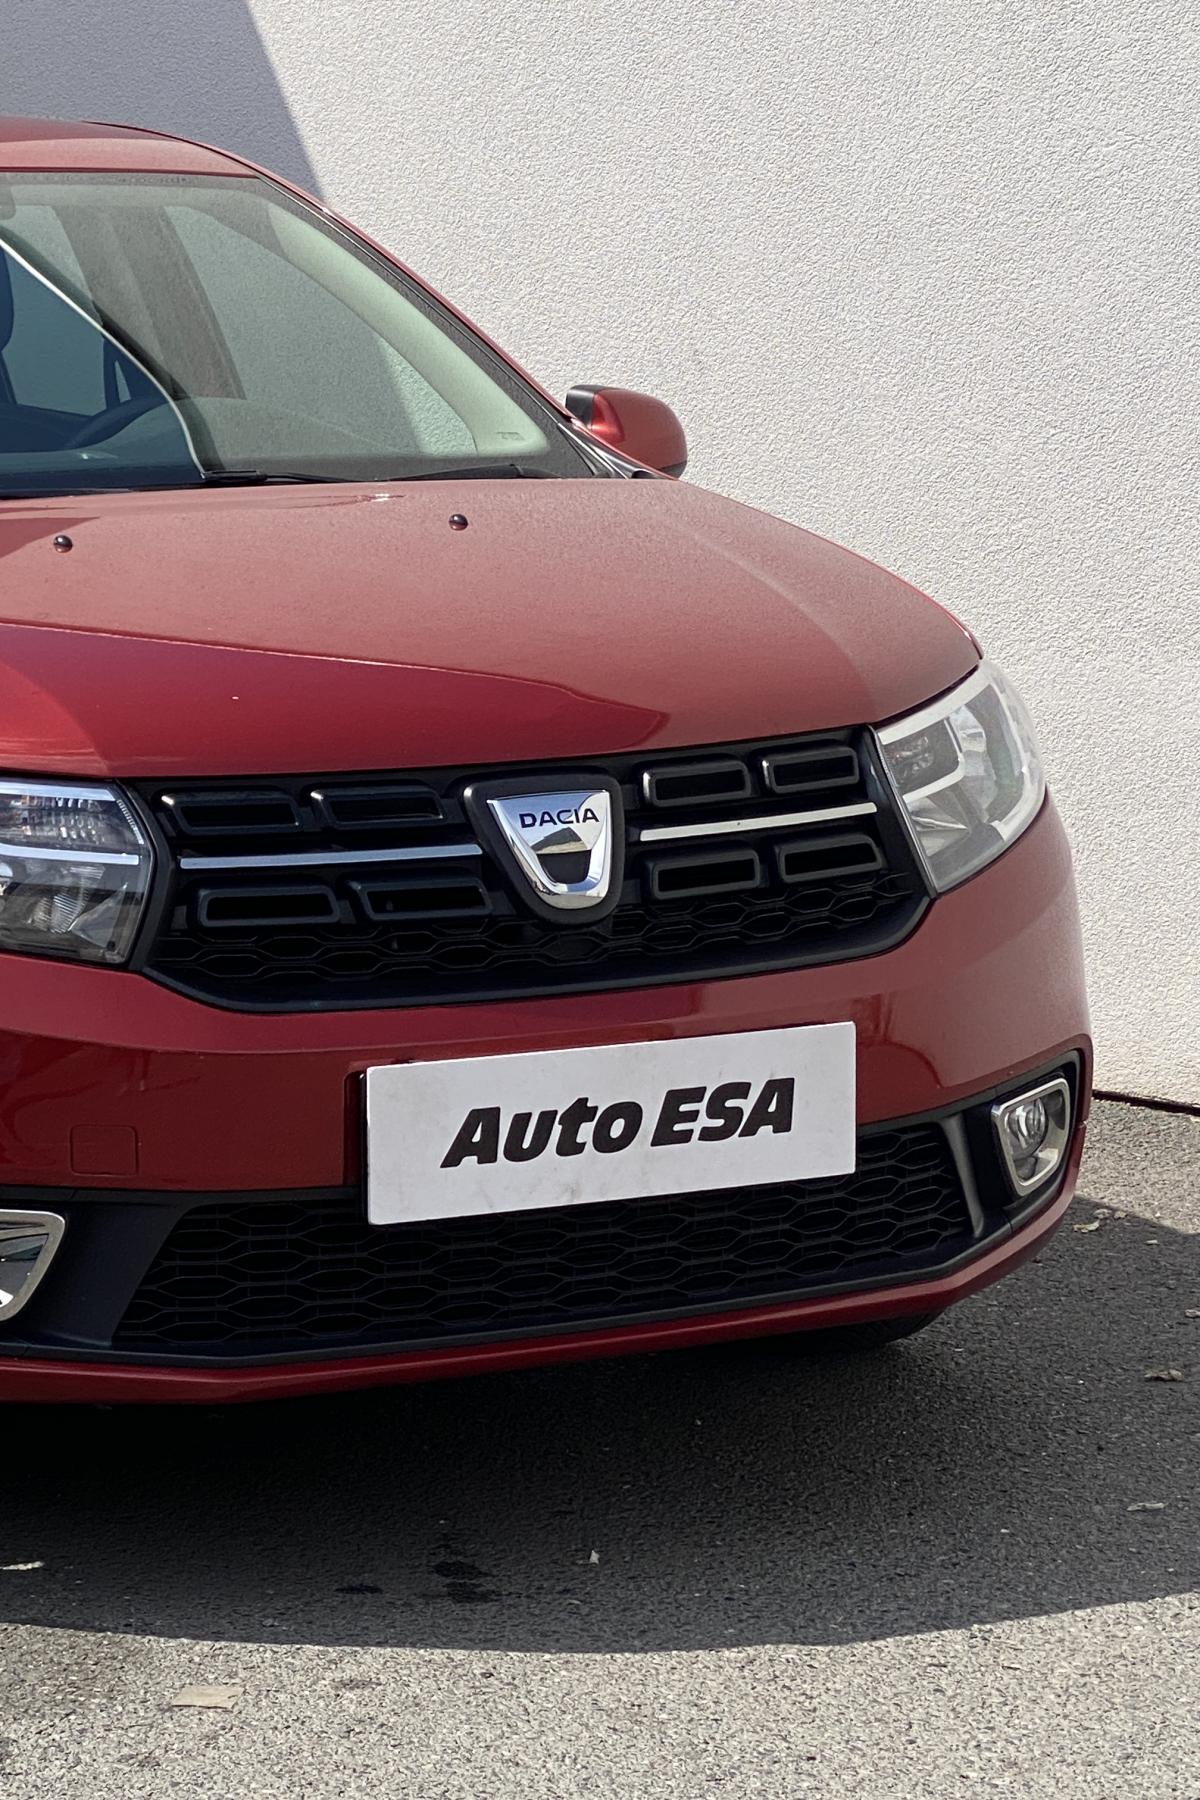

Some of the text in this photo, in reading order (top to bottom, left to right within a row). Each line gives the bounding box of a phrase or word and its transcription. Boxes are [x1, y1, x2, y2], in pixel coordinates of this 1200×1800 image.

[519, 808, 599, 829] DACIA
[441, 1077, 795, 1168] Auto ESA
